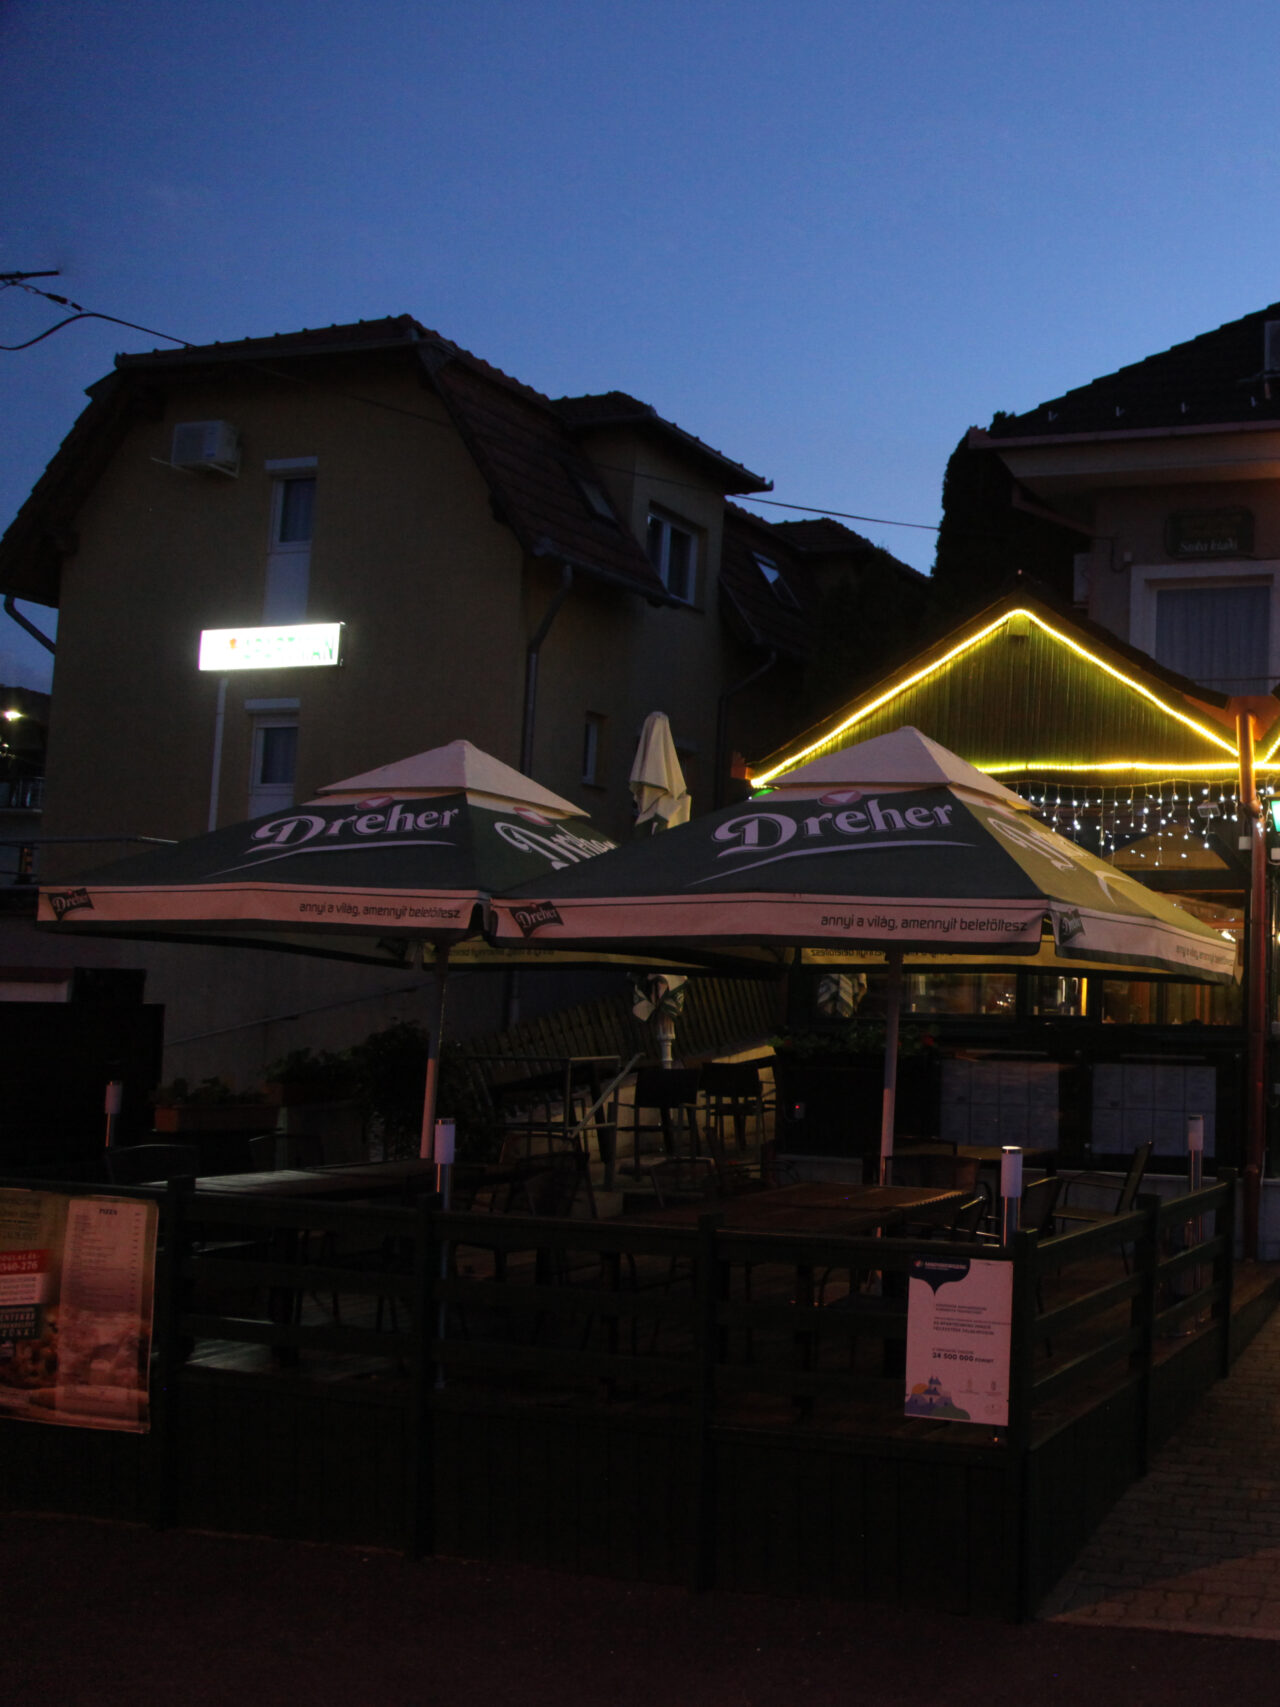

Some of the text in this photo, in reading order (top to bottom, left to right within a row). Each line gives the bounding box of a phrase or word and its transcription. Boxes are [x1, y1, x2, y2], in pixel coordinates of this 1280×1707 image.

[250, 803, 459, 850] Dreher
[711, 797, 954, 859] Dreher
[299, 902, 326, 916] annyi
[327, 904, 334, 913] a
[363, 903, 407, 919] amennyit
[821, 913, 1029, 933] annyi a világ, amennyit beletöltesz
